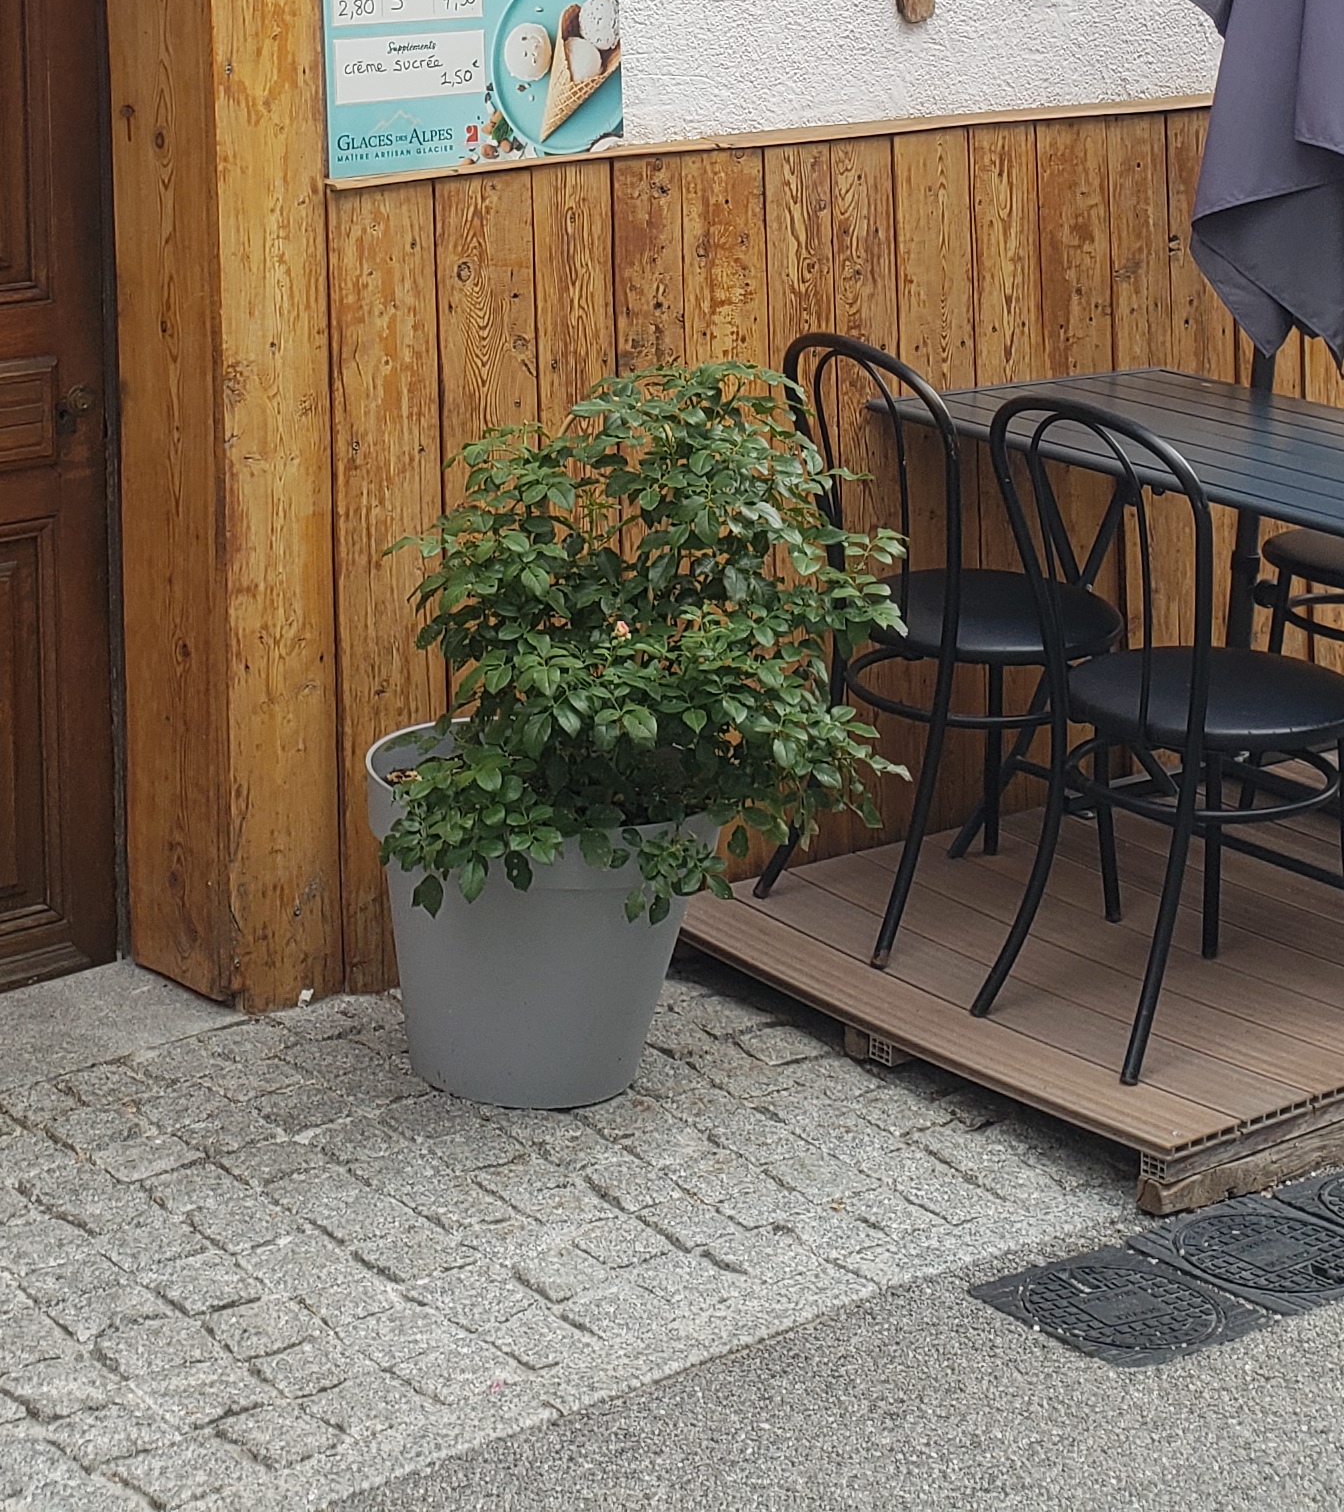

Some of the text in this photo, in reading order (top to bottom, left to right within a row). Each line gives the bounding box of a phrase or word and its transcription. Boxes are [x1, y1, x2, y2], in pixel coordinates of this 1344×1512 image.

[393, 55, 444, 72] sucrée
[337, 133, 393, 151] GLACES
[409, 127, 453, 146] ALPES
[374, 149, 411, 159] ARTISAN
[416, 144, 454, 155] GLACIER
